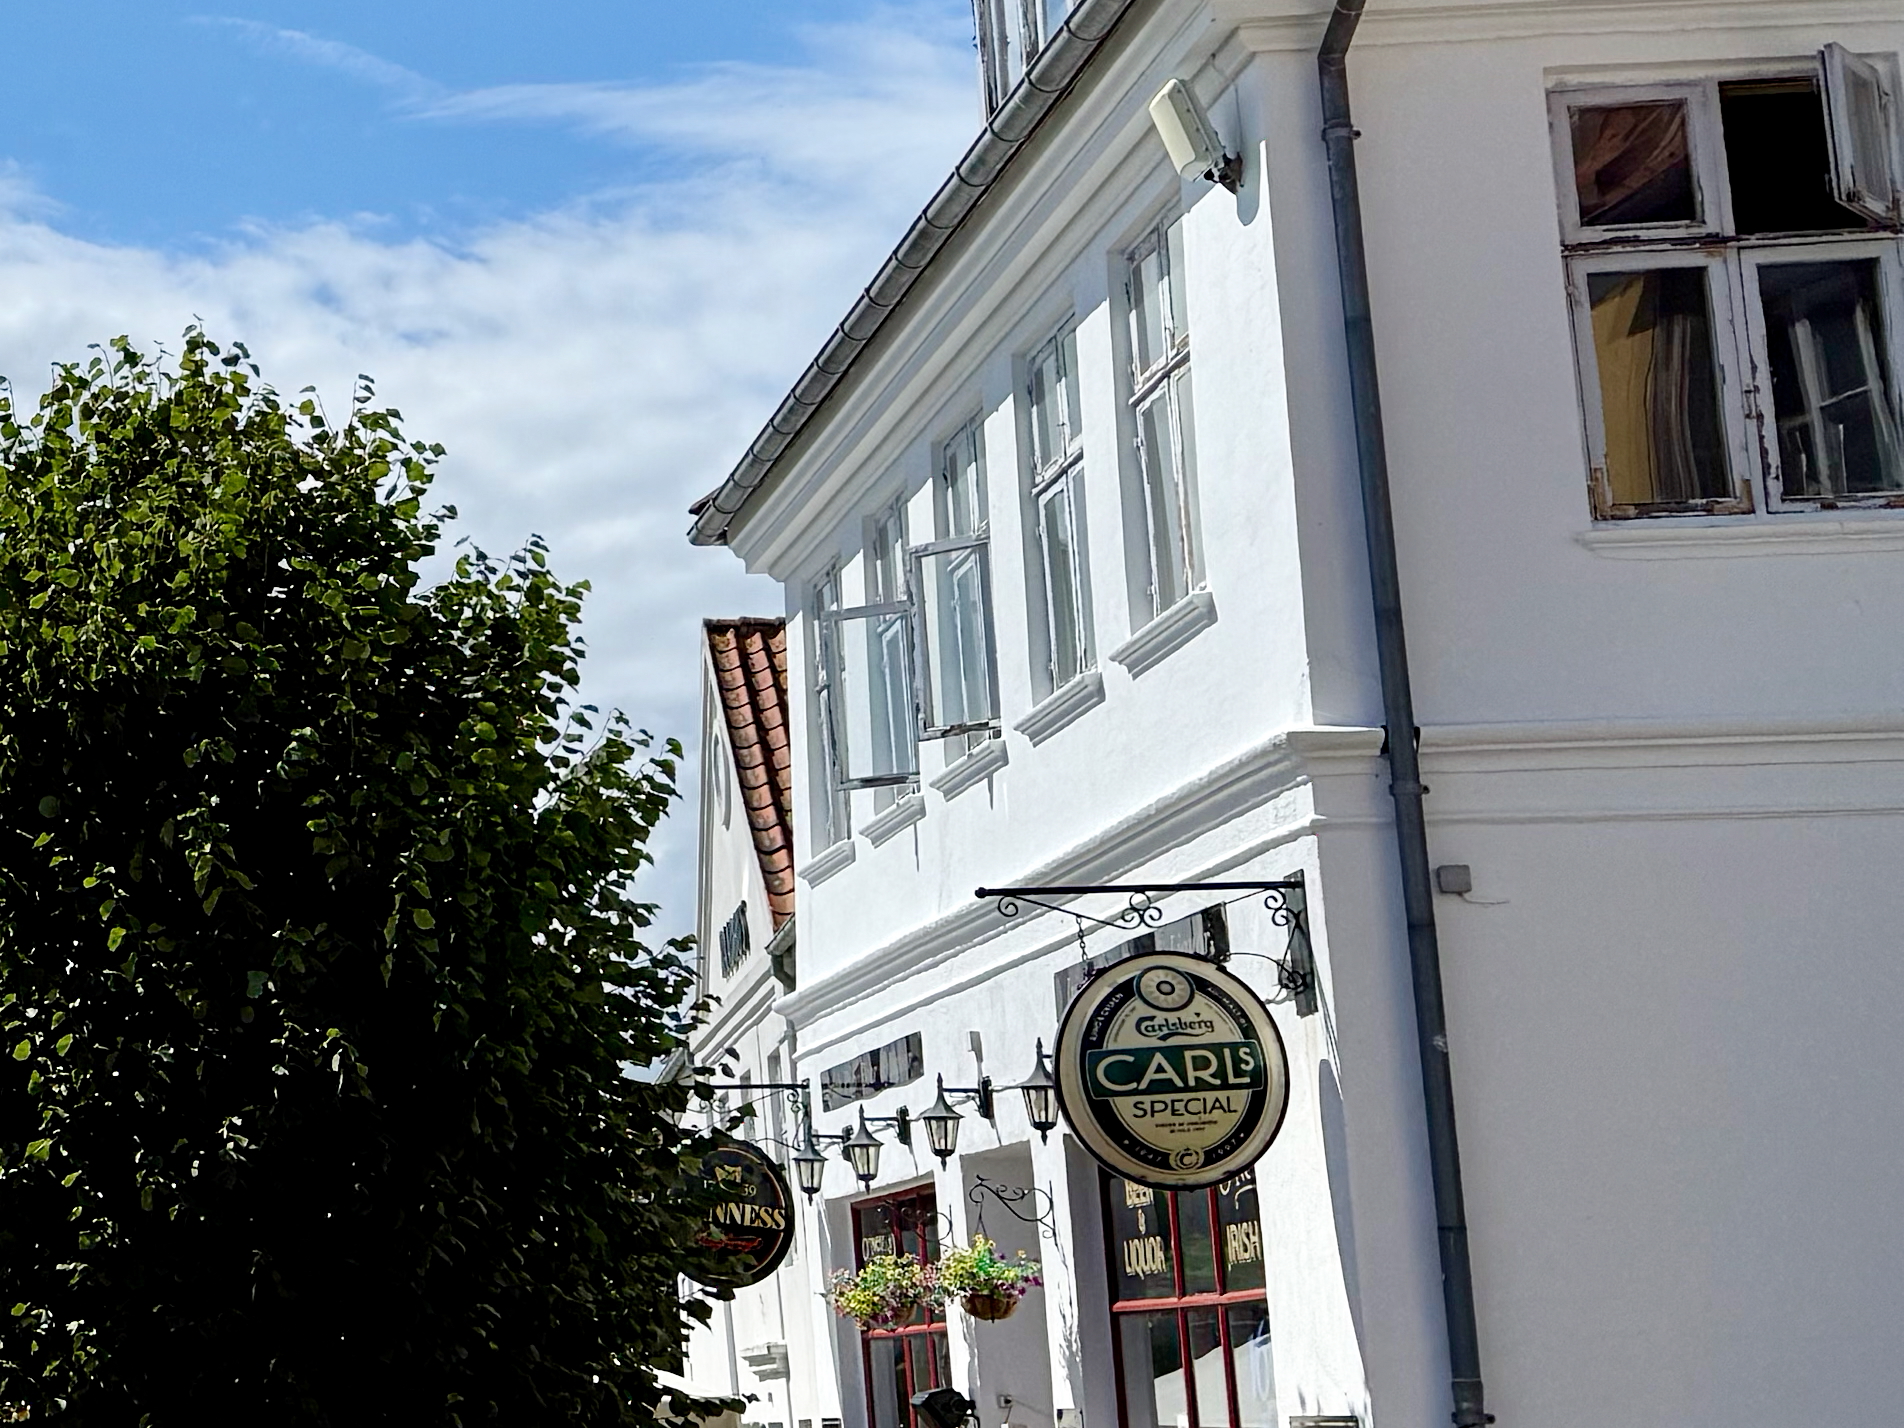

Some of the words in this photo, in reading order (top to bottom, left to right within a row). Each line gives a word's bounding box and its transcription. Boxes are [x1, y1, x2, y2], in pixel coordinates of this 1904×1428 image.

[1135, 1013, 1215, 1041] Carlsberg
[1133, 1095, 1238, 1119] SPECIAL
[704, 1201, 786, 1230] NNESS
[1123, 1235, 1167, 1280] LIQUOR
[1226, 1220, 1262, 1272] IRISH
